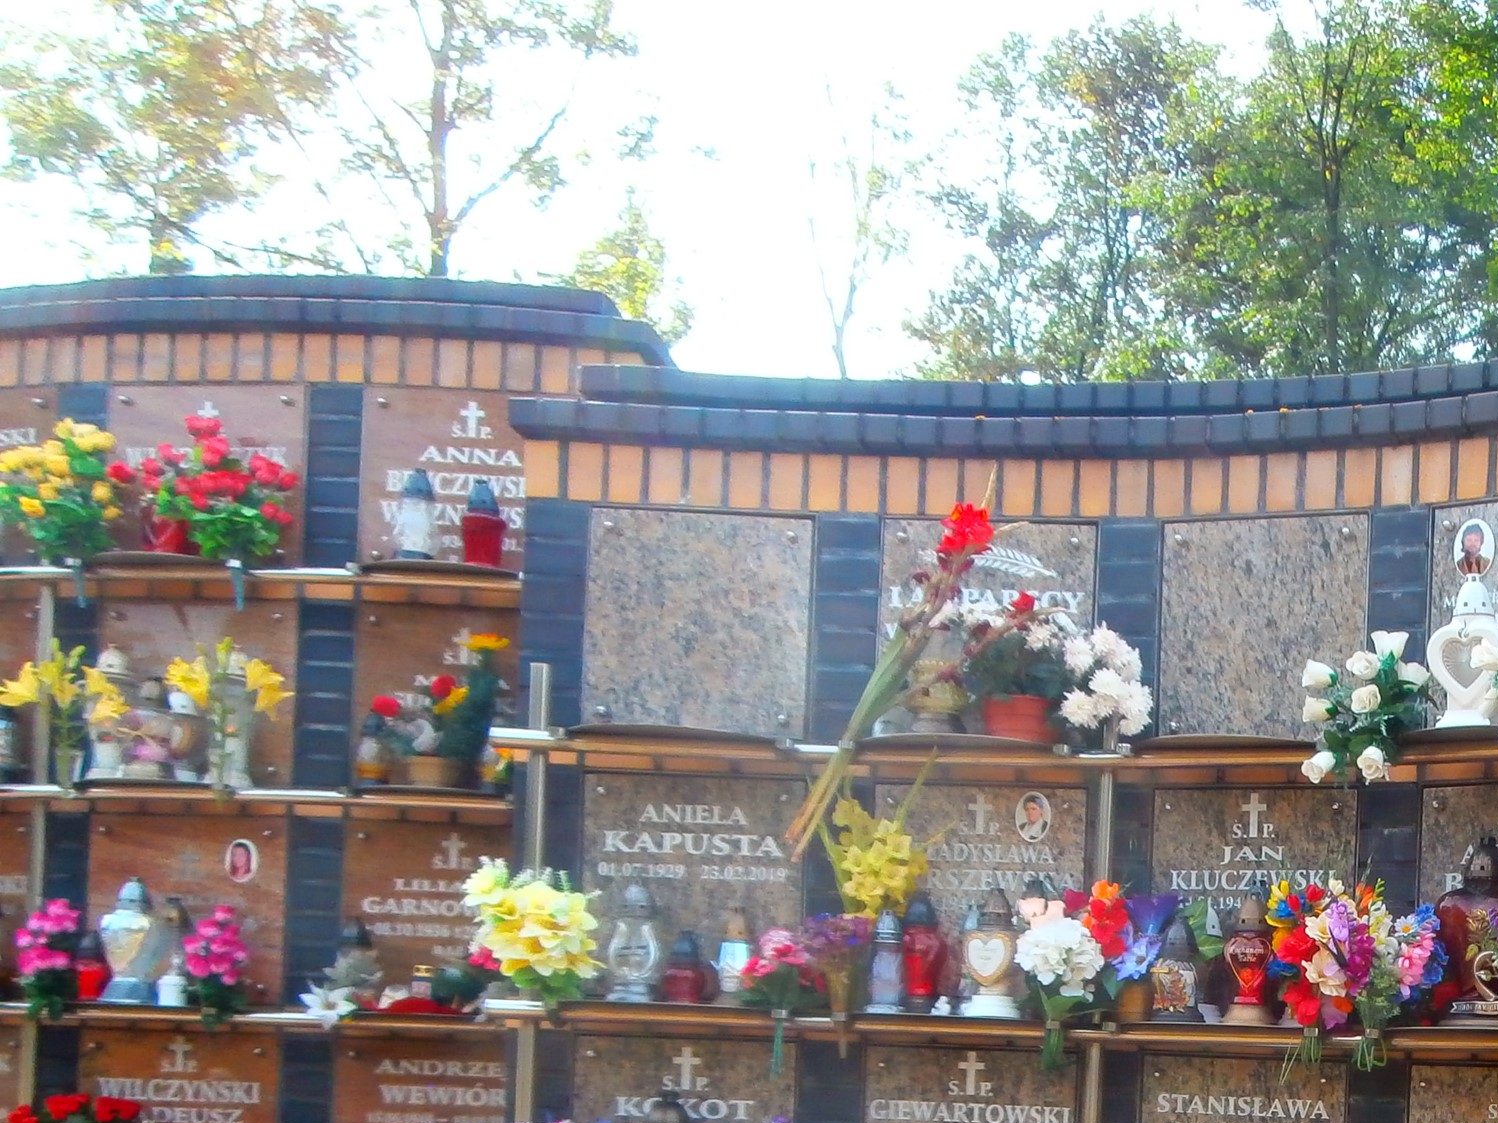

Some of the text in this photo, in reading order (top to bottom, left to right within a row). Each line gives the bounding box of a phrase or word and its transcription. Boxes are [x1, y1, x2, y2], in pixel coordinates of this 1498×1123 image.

[418, 445, 523, 467] ANNA
[639, 803, 748, 826] ANIELA
[602, 829, 784, 858] KAPUSTA
[1219, 845, 1285, 866] JAN
[1157, 1092, 1331, 1121] STANISŁAWA
